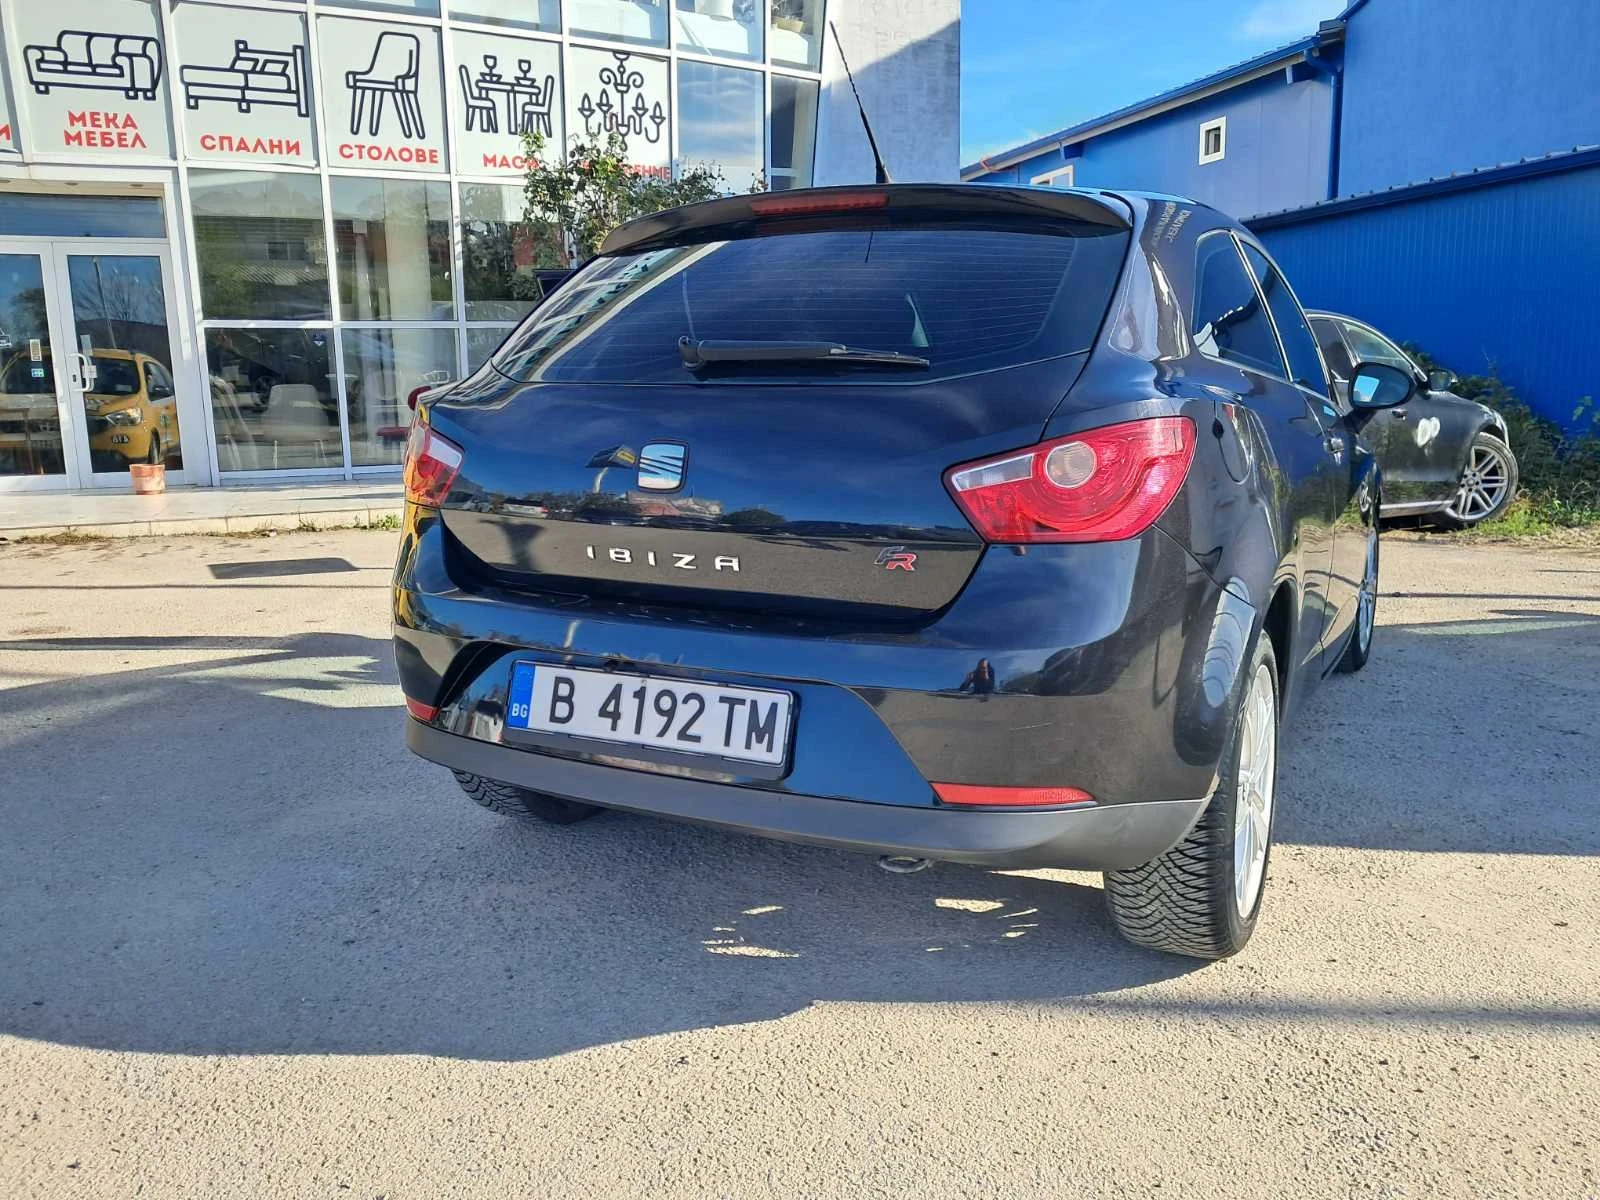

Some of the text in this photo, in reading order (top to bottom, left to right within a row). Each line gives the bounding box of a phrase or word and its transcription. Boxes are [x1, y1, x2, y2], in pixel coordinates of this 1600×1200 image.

[67, 110, 138, 130] МЕКА
[63, 129, 147, 149] МЕБЕЛ
[200, 134, 301, 156] СПАЛНИ
[339, 143, 439, 165] СТОЛОВЕ
[586, 545, 740, 572] IBIZA
[873, 545, 917, 571] FR
[512, 702, 529, 719] BG
